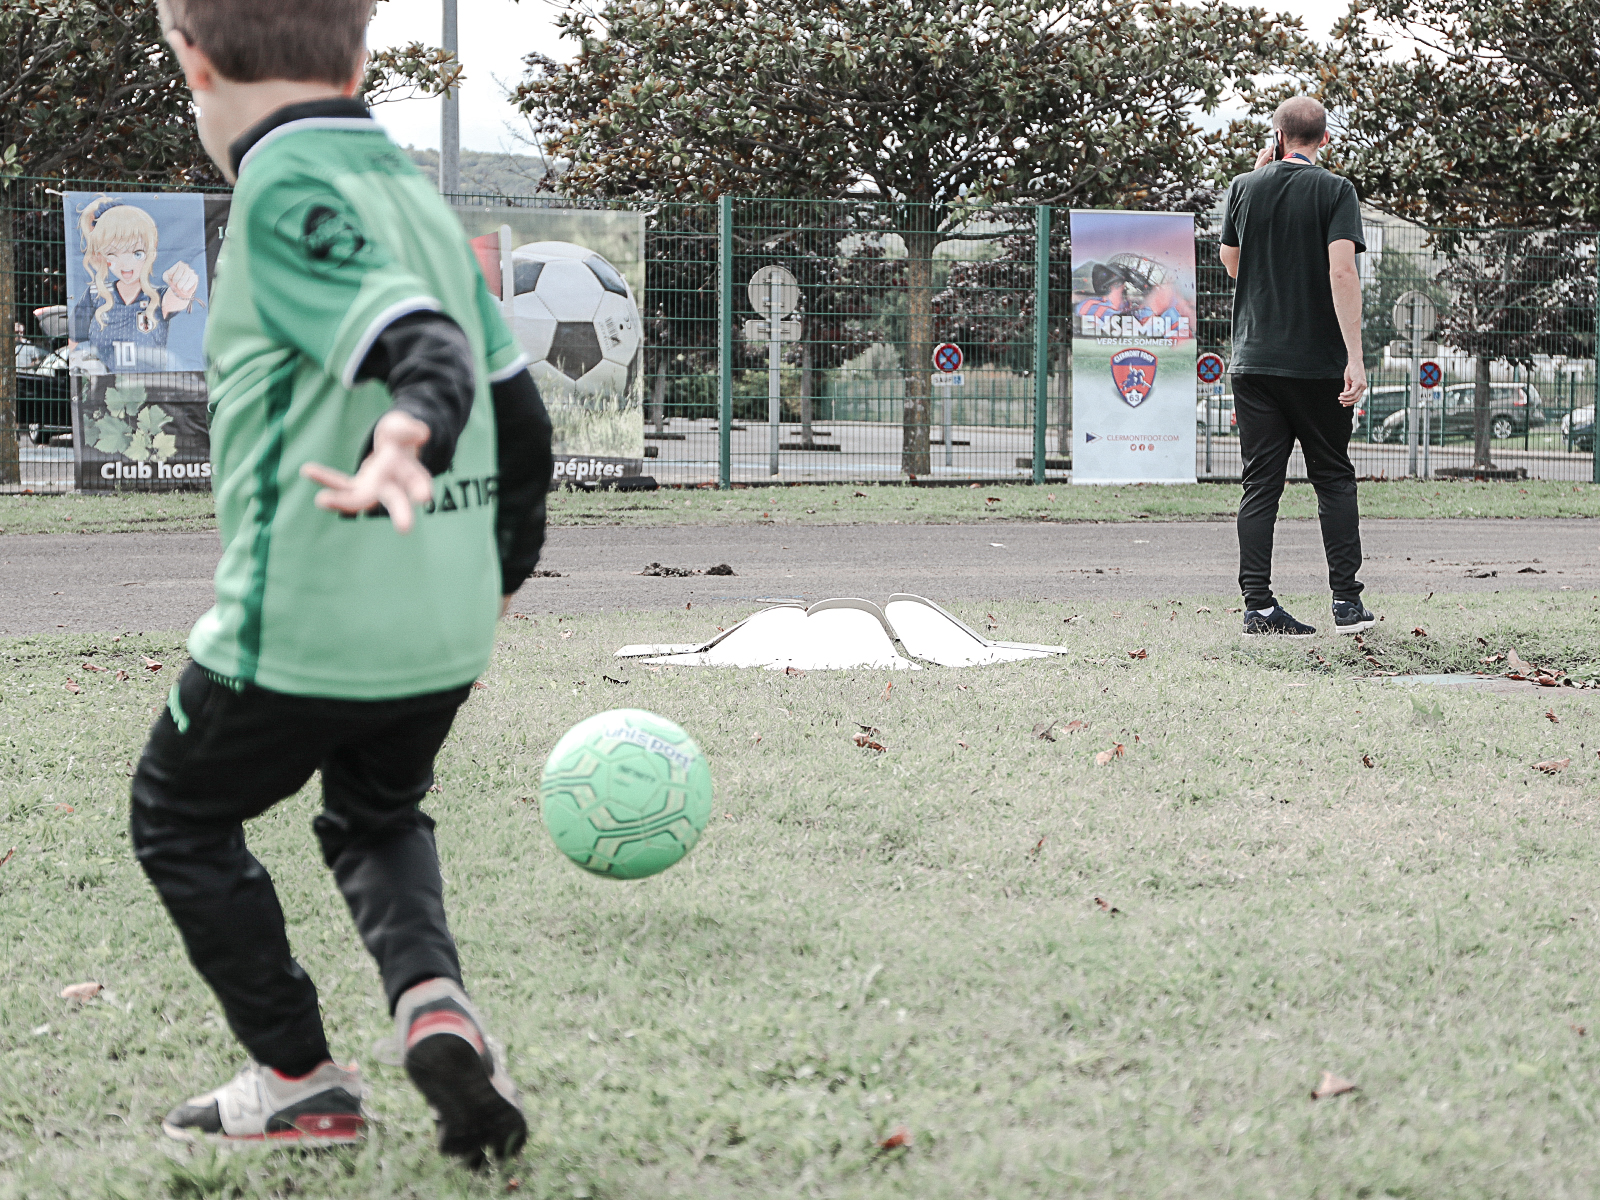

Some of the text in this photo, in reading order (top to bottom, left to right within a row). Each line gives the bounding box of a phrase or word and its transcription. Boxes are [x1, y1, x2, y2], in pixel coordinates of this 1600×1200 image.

[1081, 314, 1190, 338] ENSEMBLE
[1097, 337, 1117, 346] VERS
[1119, 338, 1133, 346] LES
[1134, 338, 1173, 347] SOMMETS
[112, 341, 136, 367] 10
[1128, 393, 1140, 402] 63
[1106, 434, 1180, 442] CLERMONTFOOT.COM
[100, 460, 153, 479] Club
[552, 457, 625, 481] pépites
[605, 727, 695, 770] uhlsport
